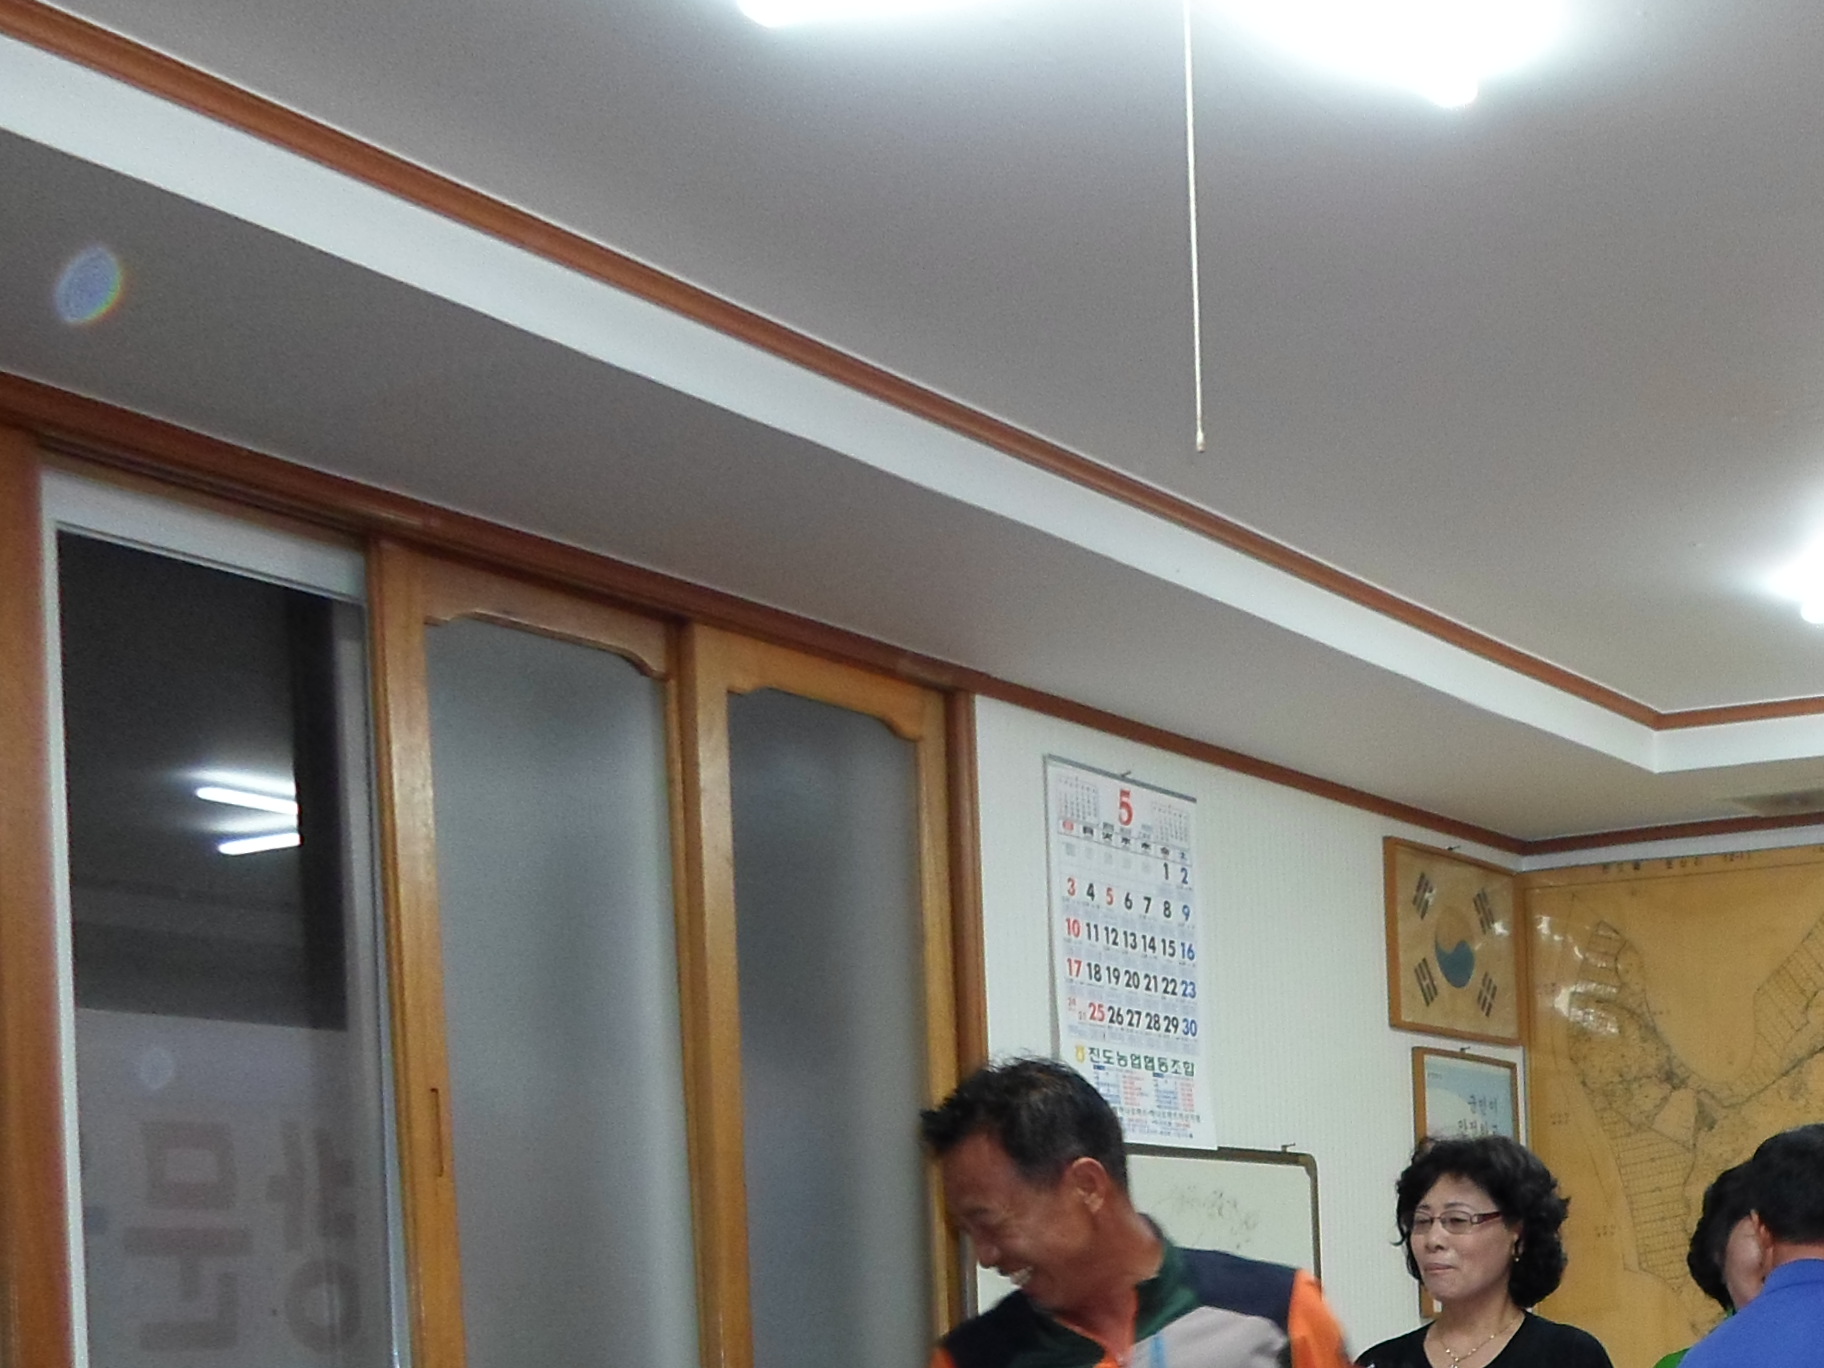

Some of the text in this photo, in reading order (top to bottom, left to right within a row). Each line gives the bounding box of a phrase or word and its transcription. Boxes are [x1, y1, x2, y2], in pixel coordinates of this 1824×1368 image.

[1118, 789, 1133, 826] 5
[1163, 862, 1189, 885] 1 2
[1067, 877, 1191, 922] 3 4 5 6 7 8 9
[1066, 918, 1195, 961] 10 11 12 13 14 15 16
[1067, 958, 1197, 999] 17 18 19 20 21 22 23
[1089, 1002, 1105, 1022] 25
[1107, 1005, 1124, 1025] 26
[1126, 1009, 1142, 1028] 27
[1145, 1012, 1161, 1032] 28
[1163, 1015, 1179, 1034] 29
[1182, 1018, 1197, 1037] 30
[1088, 1046, 1195, 1077] 진도농업협동조합
